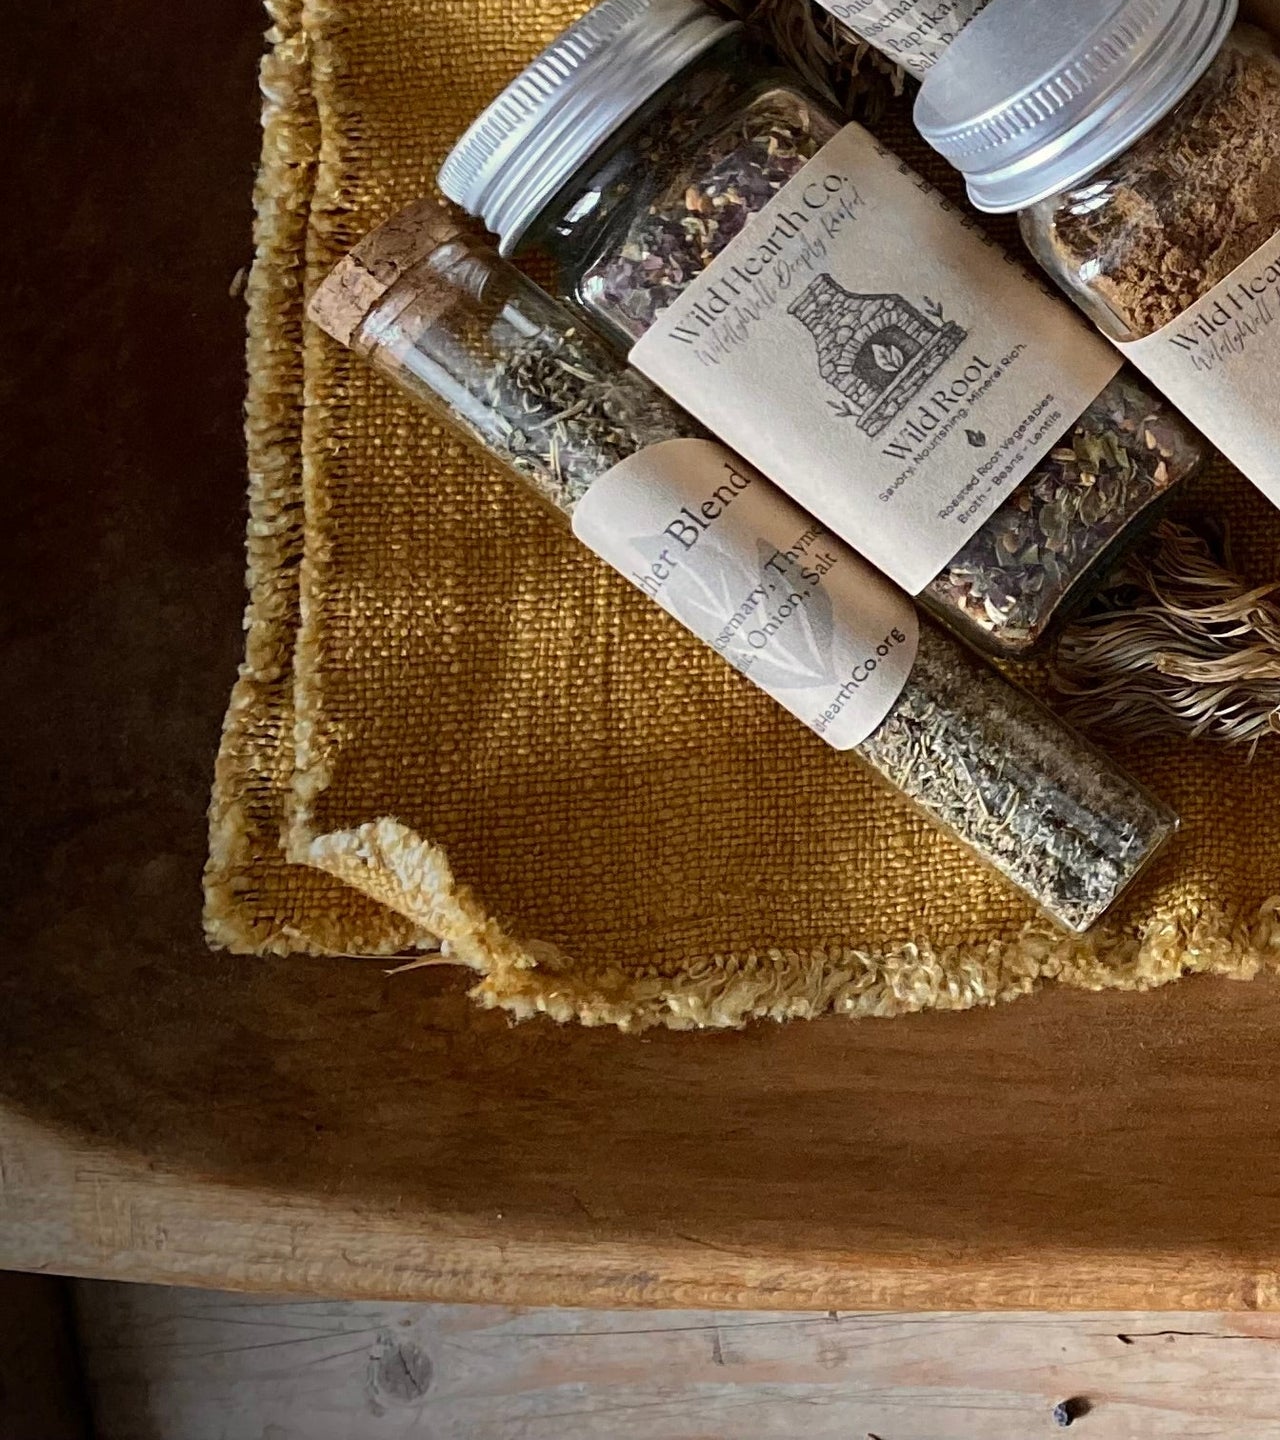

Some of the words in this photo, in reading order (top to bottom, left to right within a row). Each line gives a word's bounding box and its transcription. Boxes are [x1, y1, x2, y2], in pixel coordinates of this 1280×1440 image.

[669, 290, 729, 346] Wild
[725, 206, 808, 296] Hearth
[802, 172, 849, 211] Co.
[967, 370, 1001, 405] Mineral
[1000, 343, 1027, 369] Rich.
[1169, 295, 1231, 352] Wild
[882, 398, 940, 463] Wild
[932, 355, 991, 414] Root
[938, 473, 979, 520] Roasted
[977, 444, 1001, 477] Root
[1000, 393, 1054, 451] Vegetables
[665, 463, 751, 551] Blend
[957, 494, 986, 525] Broth
[993, 454, 1024, 487] Beans
[1029, 410, 1062, 447] Lentils
[748, 589, 810, 650] Onion,
[800, 552, 838, 587] Salt
